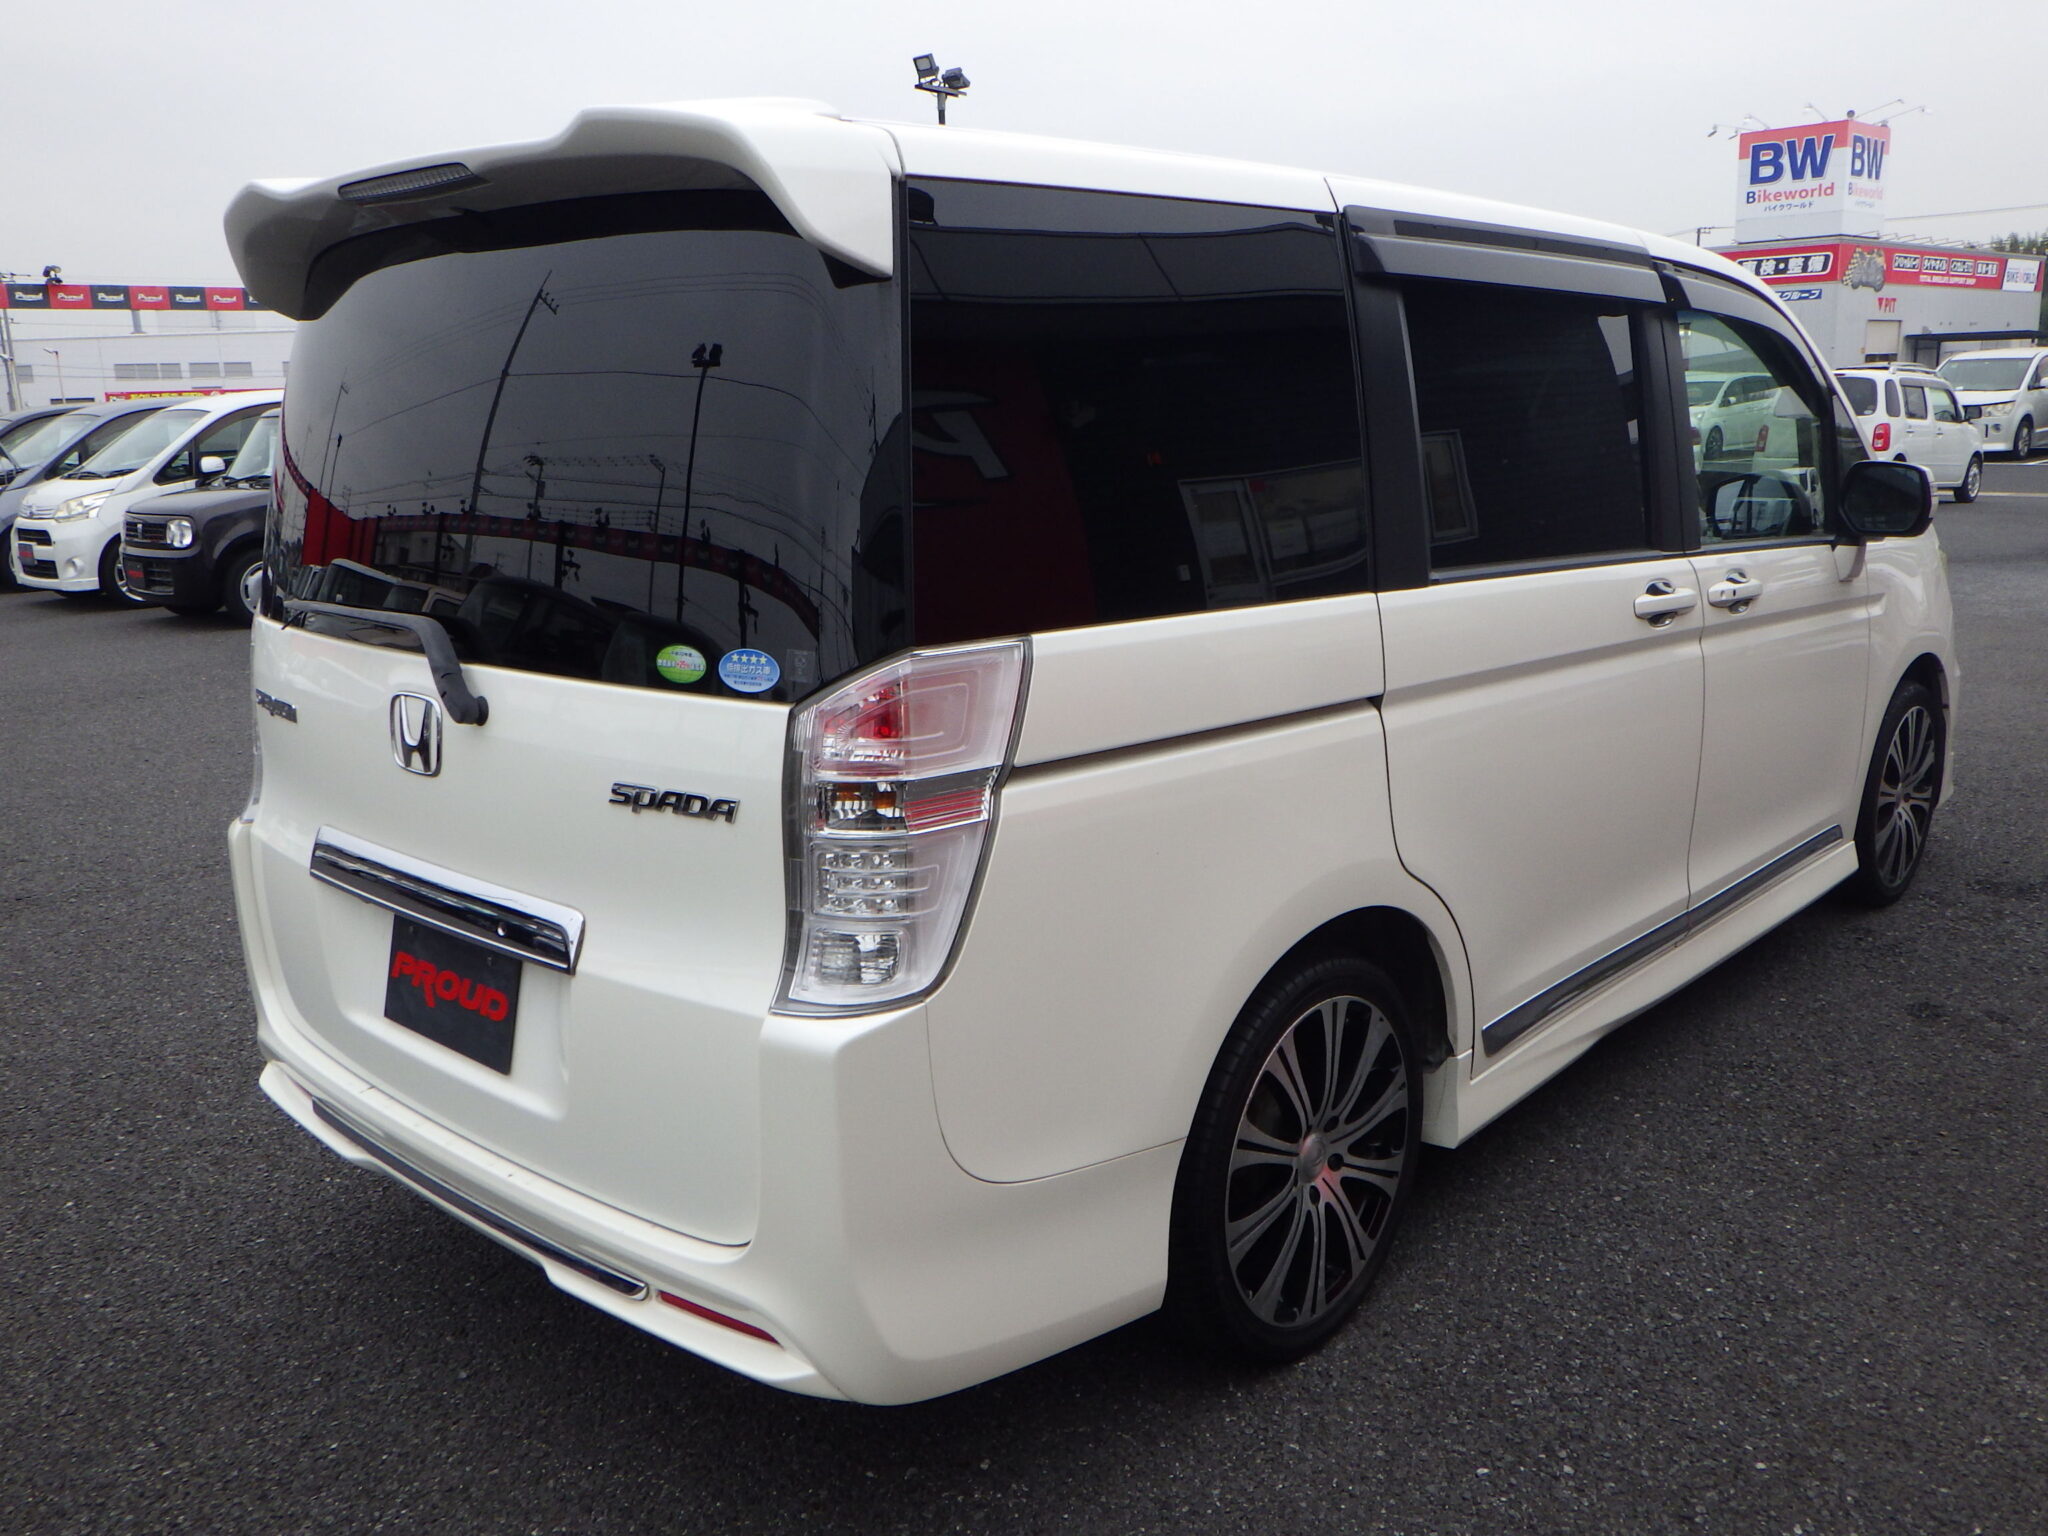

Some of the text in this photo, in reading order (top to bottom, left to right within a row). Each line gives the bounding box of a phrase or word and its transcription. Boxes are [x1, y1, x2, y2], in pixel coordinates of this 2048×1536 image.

[1750, 134, 1836, 186] BW
[1851, 134, 1885, 180] BW
[1746, 182, 1835, 204] Bikeworld
[608, 782, 741, 825] SPADA
[391, 951, 510, 1022] PROUD
